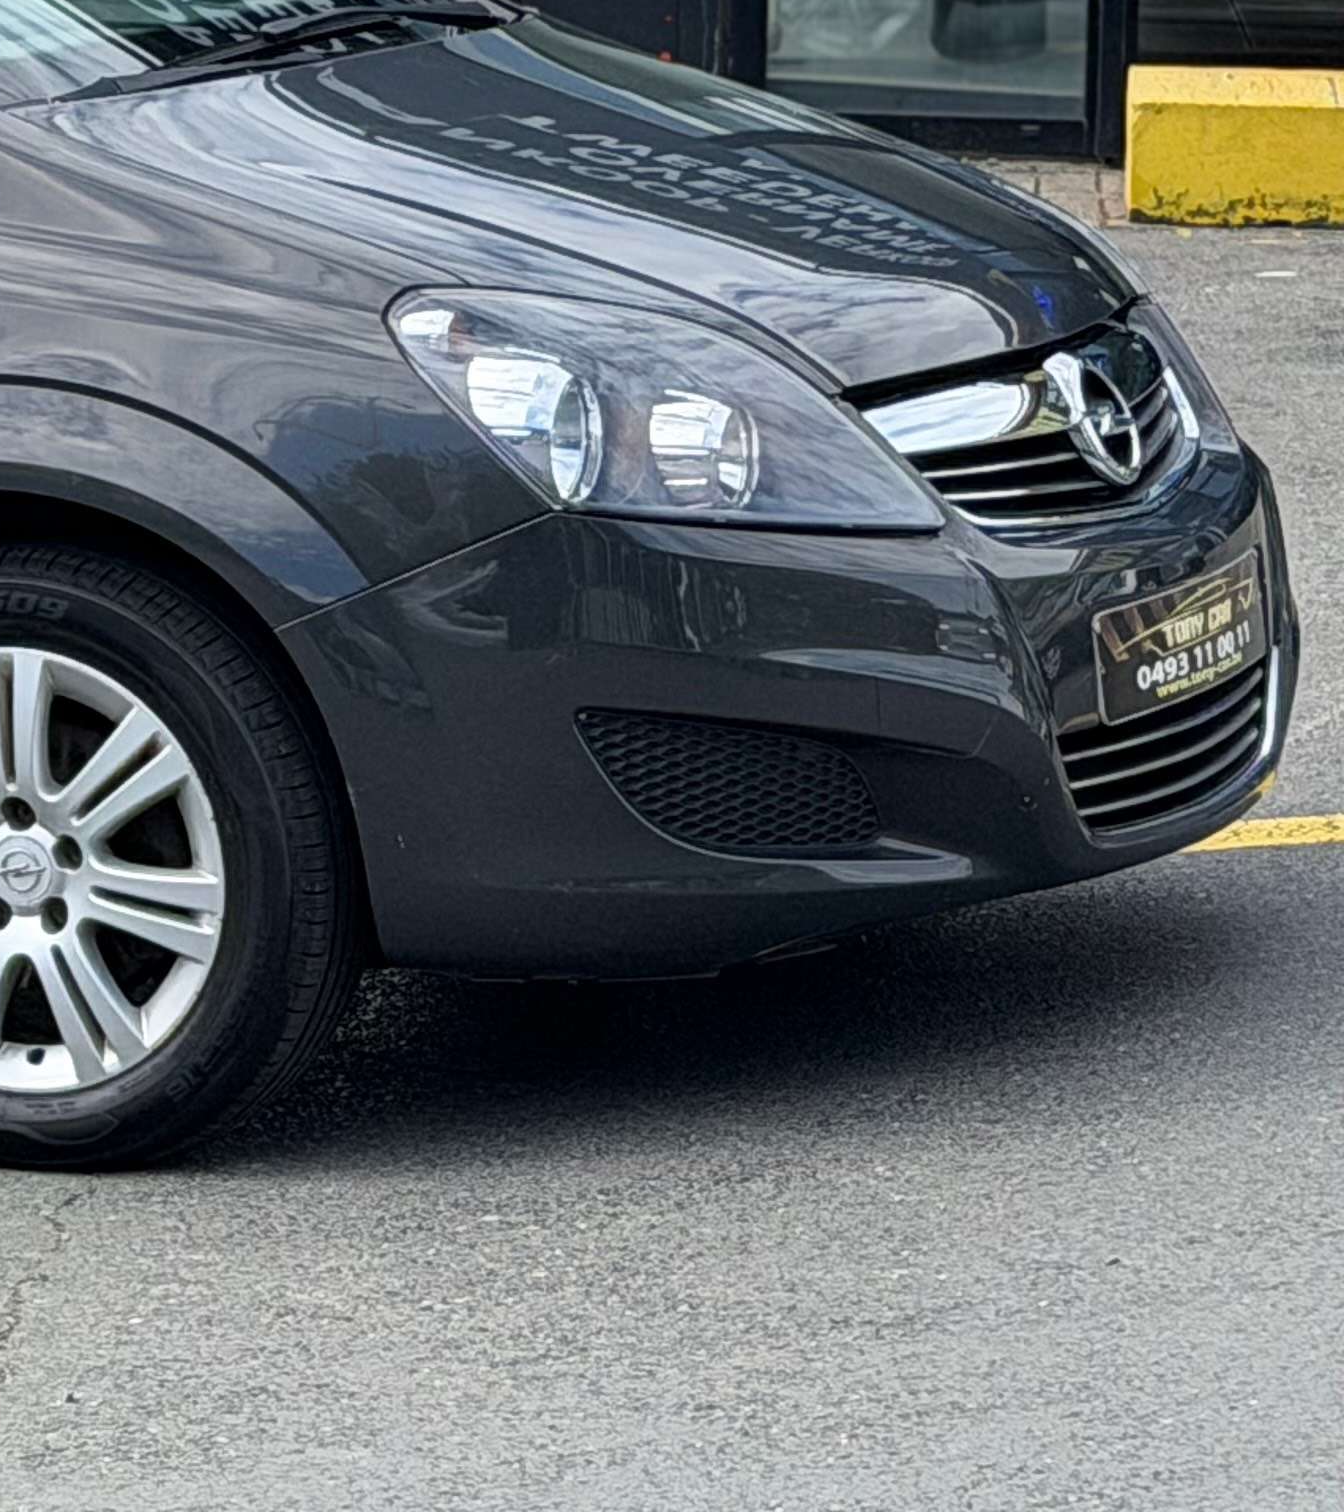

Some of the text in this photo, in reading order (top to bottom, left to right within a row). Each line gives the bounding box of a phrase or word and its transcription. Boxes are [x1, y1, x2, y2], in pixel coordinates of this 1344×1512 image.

[1137, 620, 1250, 690] 0493 11 00 11
[1162, 612, 1205, 648] TONY
